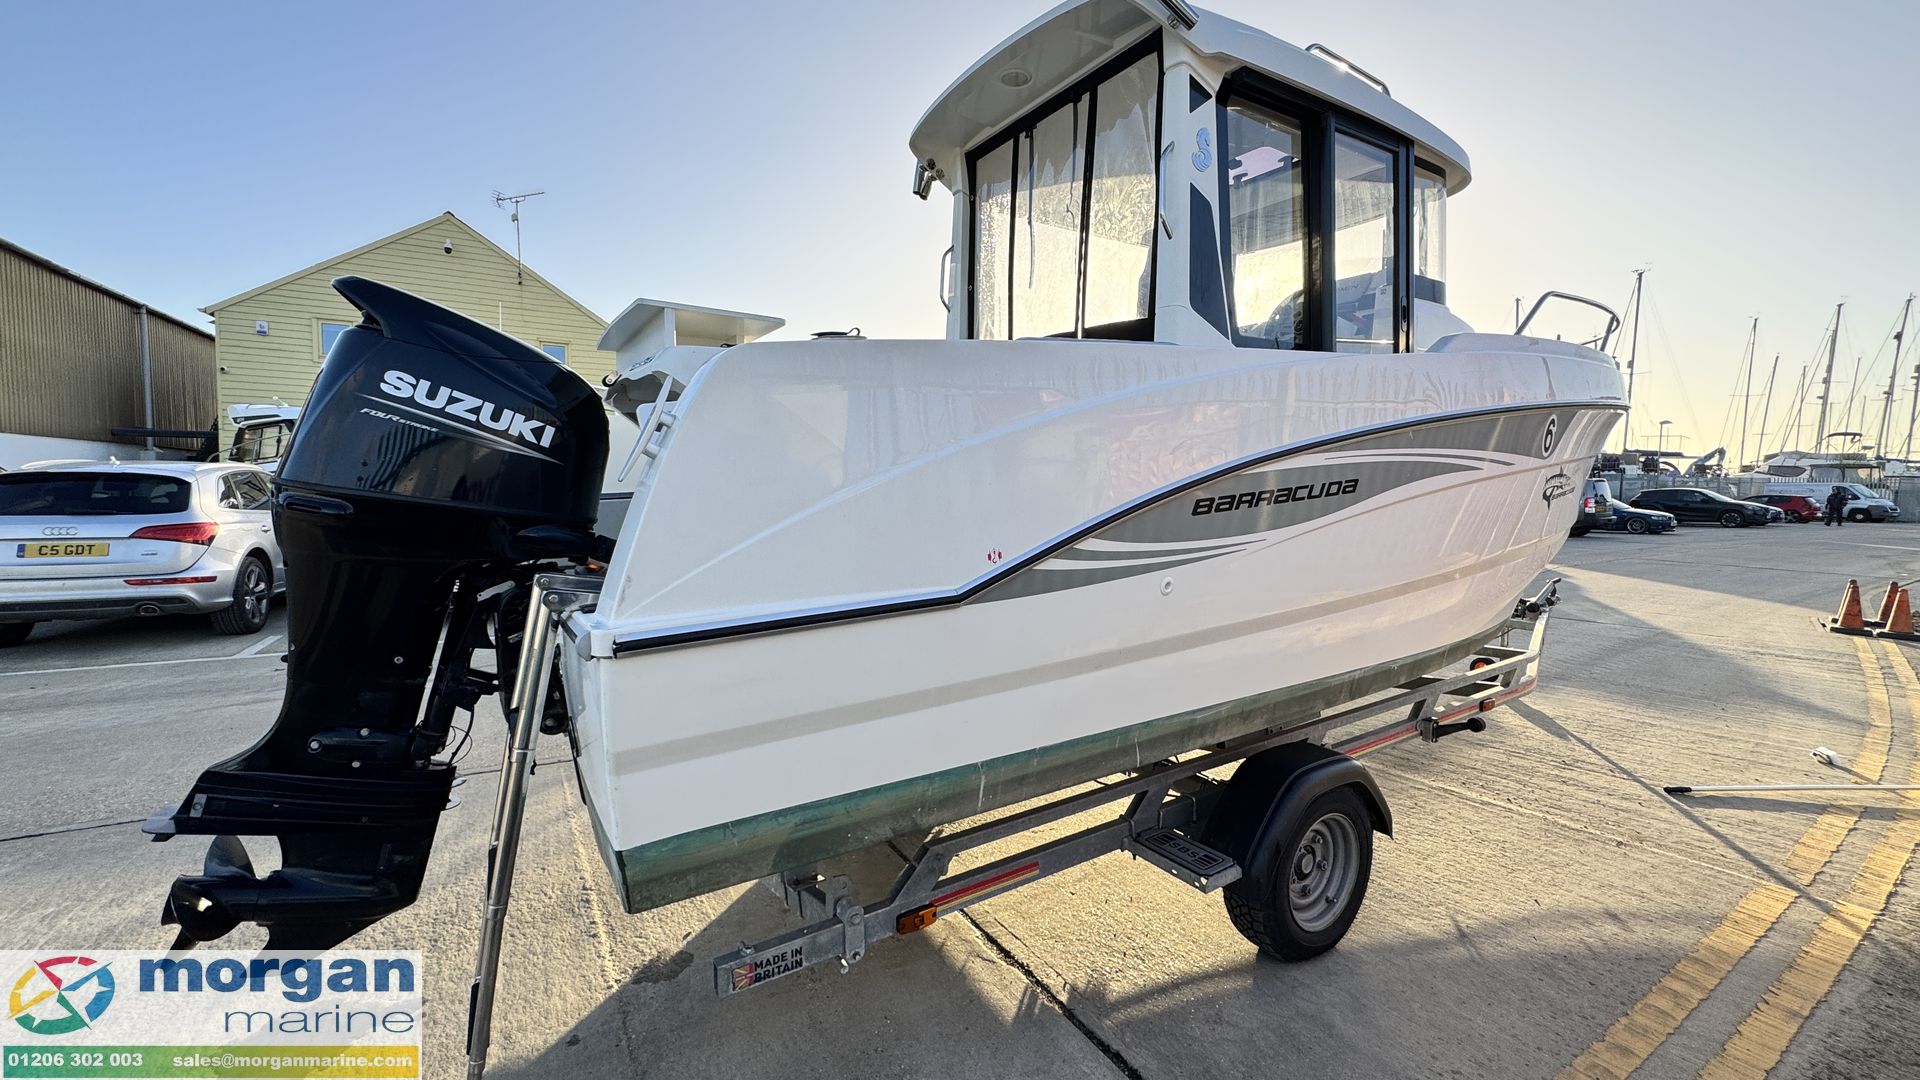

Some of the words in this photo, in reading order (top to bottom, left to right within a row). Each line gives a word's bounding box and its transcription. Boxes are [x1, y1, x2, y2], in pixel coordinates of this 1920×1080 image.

[360, 408, 400, 421] FOUR
[380, 370, 555, 448] SUZUKI
[1544, 418, 1555, 453] 6
[38, 545, 59, 556] C5
[64, 544, 95, 555] GDT
[1168, 841, 1200, 859] SBS
[754, 951, 788, 972] MADE
[791, 946, 803, 959] IN
[755, 957, 803, 983] BRITAIN
